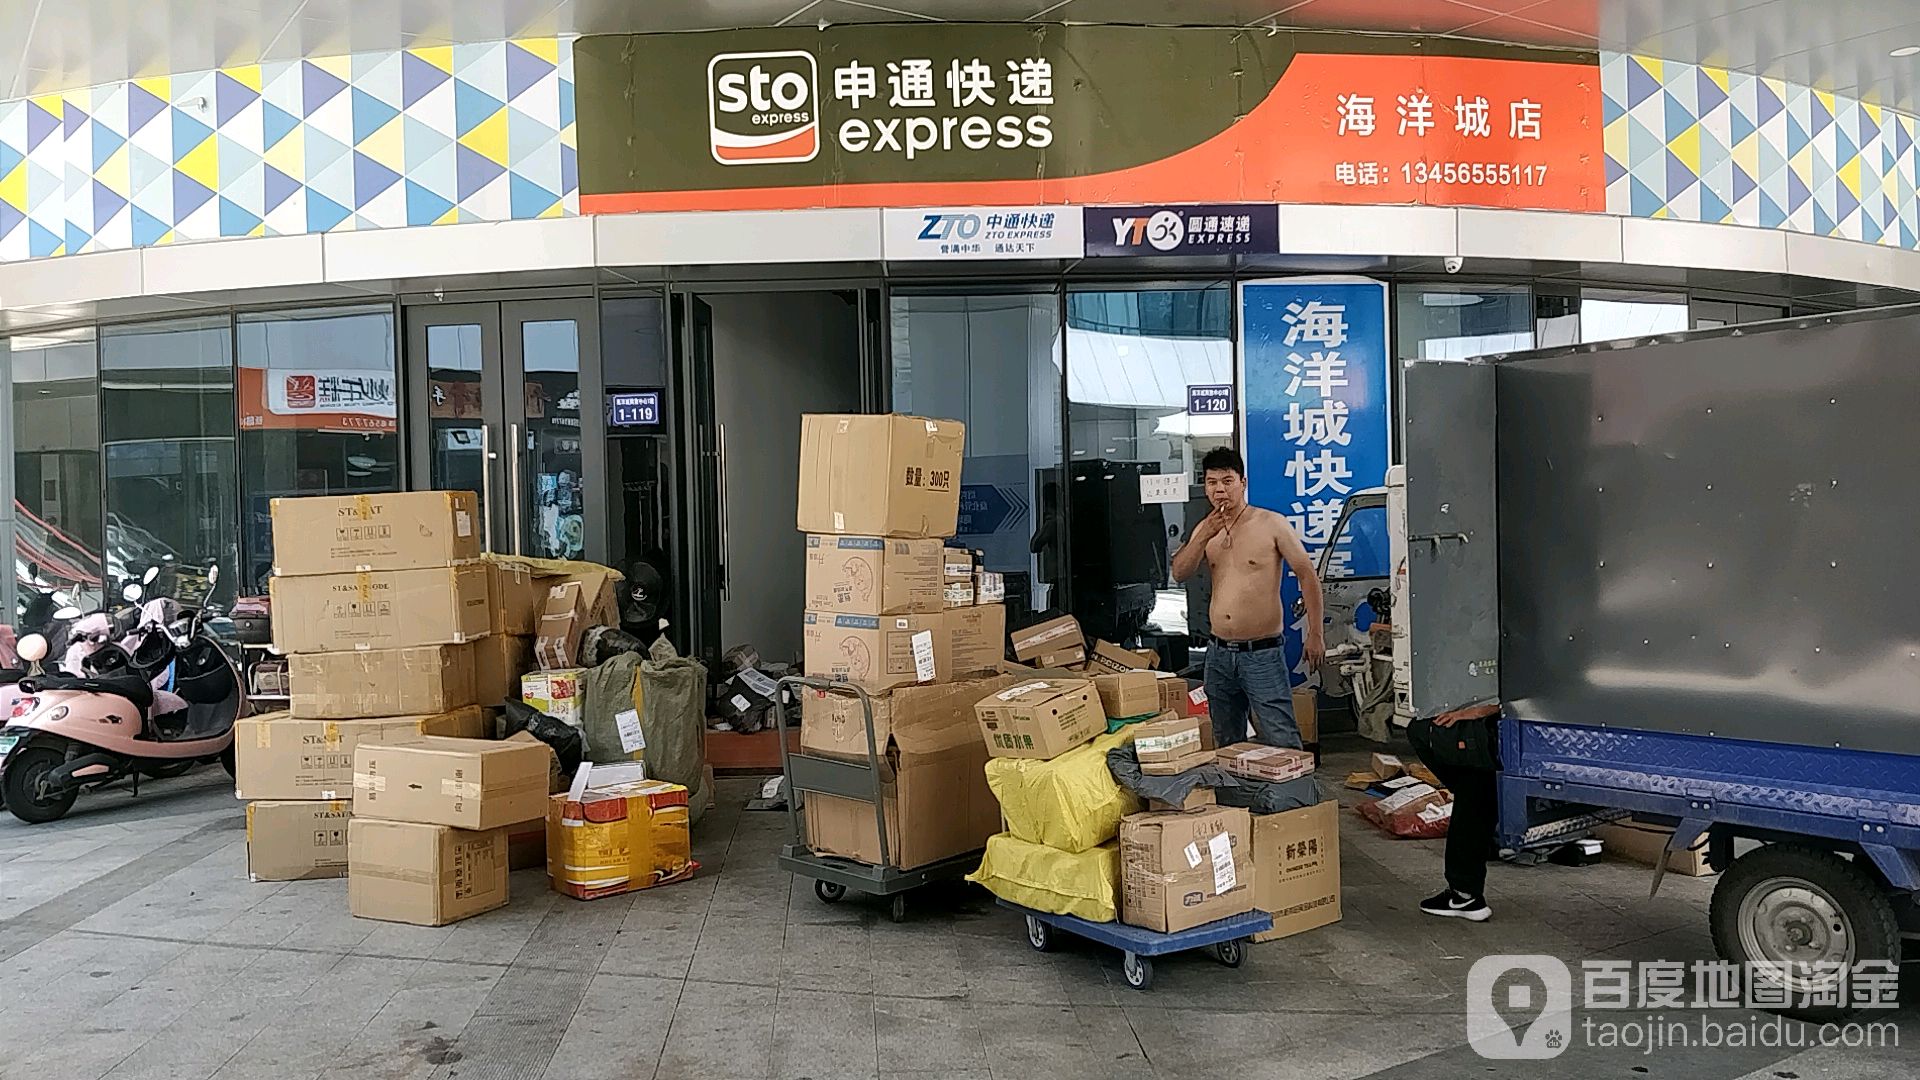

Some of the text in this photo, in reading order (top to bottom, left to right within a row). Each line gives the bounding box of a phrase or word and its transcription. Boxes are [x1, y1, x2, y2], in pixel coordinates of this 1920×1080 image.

[718, 66, 809, 113] sto
[833, 57, 1056, 110] 申通快递
[752, 110, 810, 127] express
[1336, 93, 1543, 141] 海洋城店
[838, 115, 1055, 160] express
[1401, 163, 1548, 187] 13456555117
[917, 214, 982, 241] ZTO
[986, 212, 1055, 230] 中通快递
[985, 229, 1053, 240] ZTO EXPRESS
[1188, 233, 1251, 246] EXPRESS
[994, 243, 1036, 254] 通达天下
[618, 407, 653, 421] 1-119
[1194, 398, 1228, 412] 1-120
